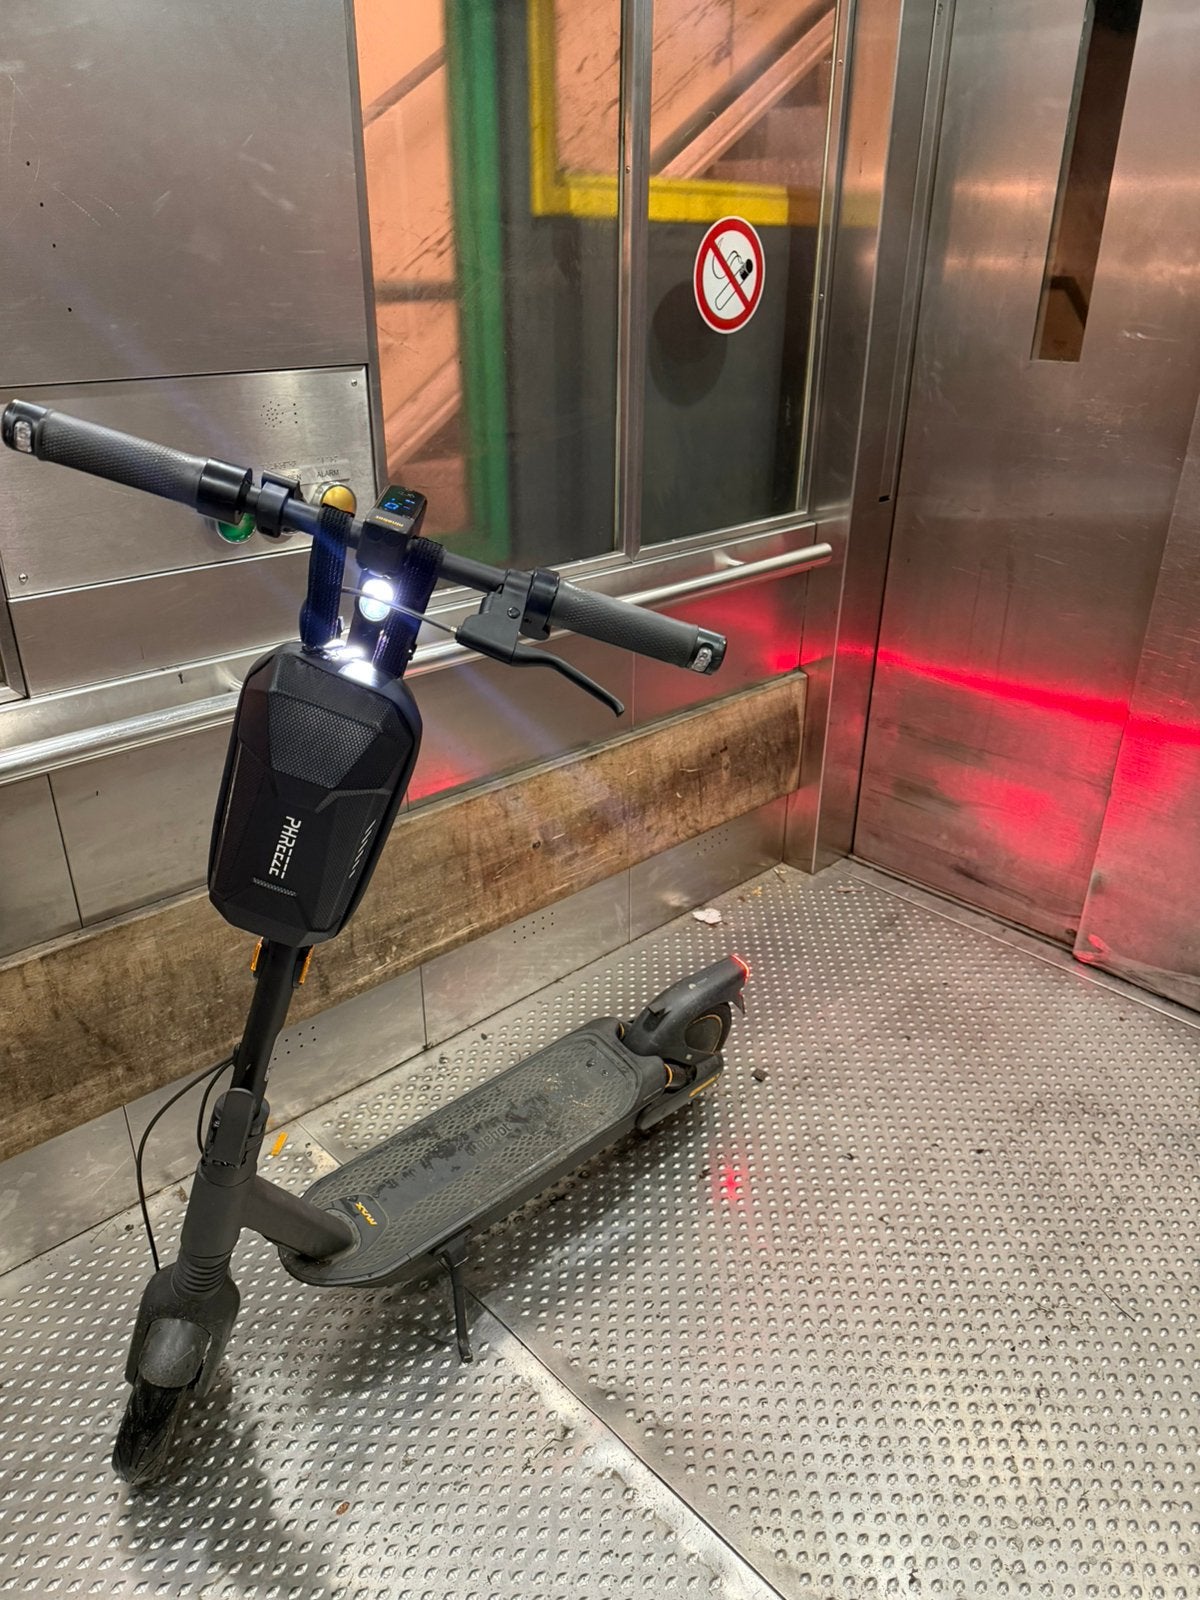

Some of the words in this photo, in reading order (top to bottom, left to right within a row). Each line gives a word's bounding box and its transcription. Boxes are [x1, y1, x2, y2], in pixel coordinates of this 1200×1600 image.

[316, 469, 339, 478] ALARM
[268, 815, 302, 880] PHREEZE
[354, 1201, 378, 1226] MAX
